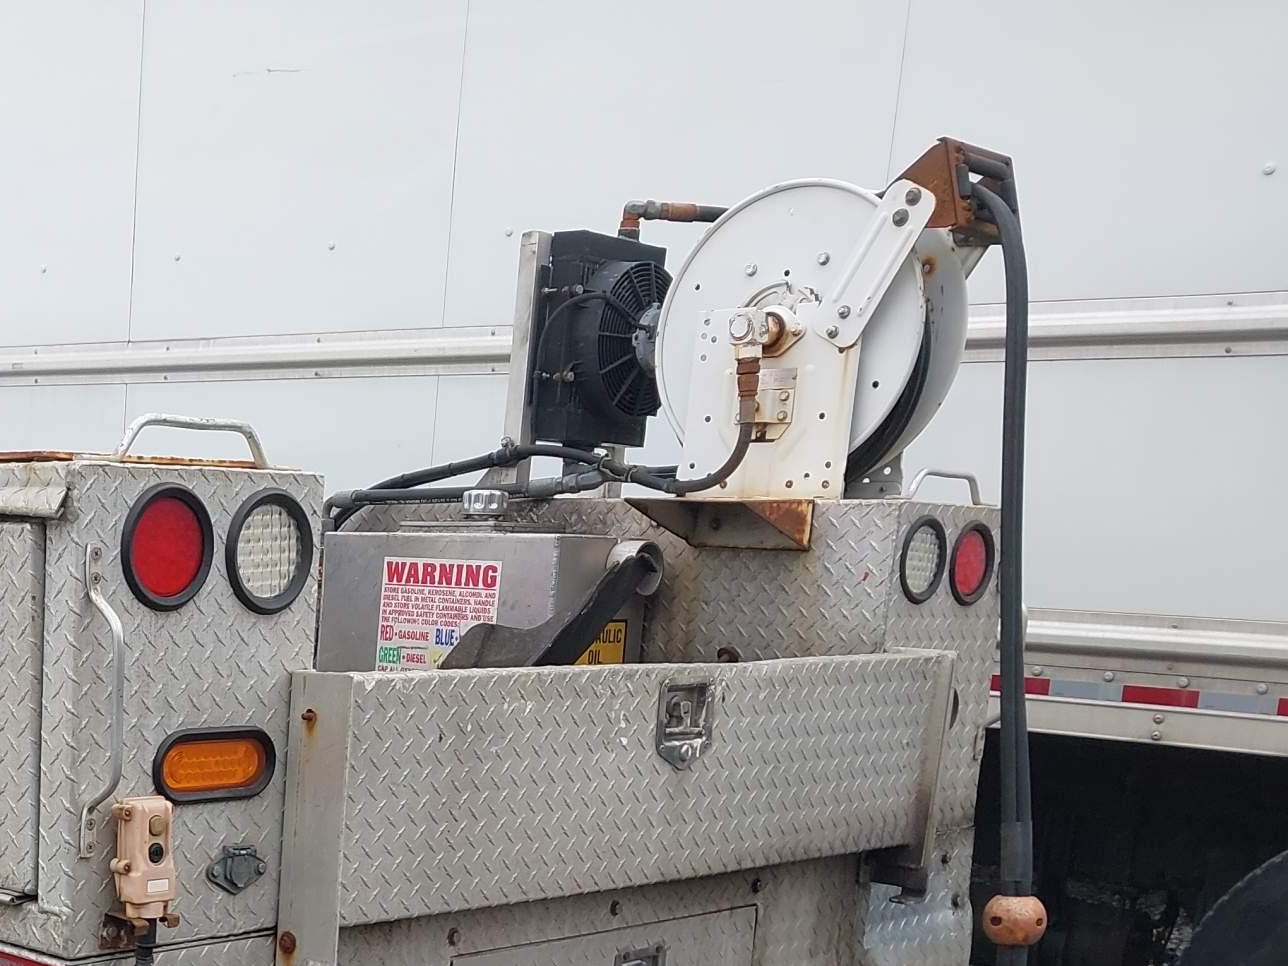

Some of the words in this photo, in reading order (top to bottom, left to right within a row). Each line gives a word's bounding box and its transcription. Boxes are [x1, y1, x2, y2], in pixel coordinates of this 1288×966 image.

[387, 561, 498, 588] WARNING
[384, 586, 400, 594] STORE
[484, 592, 496, 600] AND
[420, 596, 437, 604] METAL
[388, 609, 415, 617] APPROVED
[436, 612, 469, 620] CONTAINERS
[470, 614, 482, 622] AND
[411, 603, 435, 611] VOLATILE
[435, 604, 468, 613] FLAMMABLE
[469, 606, 491, 614] LIQUIDS
[421, 618, 438, 626] COLOR
[380, 624, 394, 641] RED
[398, 630, 430, 641] GASOLINE
[434, 628, 455, 646] BLUE
[378, 646, 402, 664] GREEN
[406, 652, 426, 664] DIESEL
[588, 650, 602, 664] OIL
